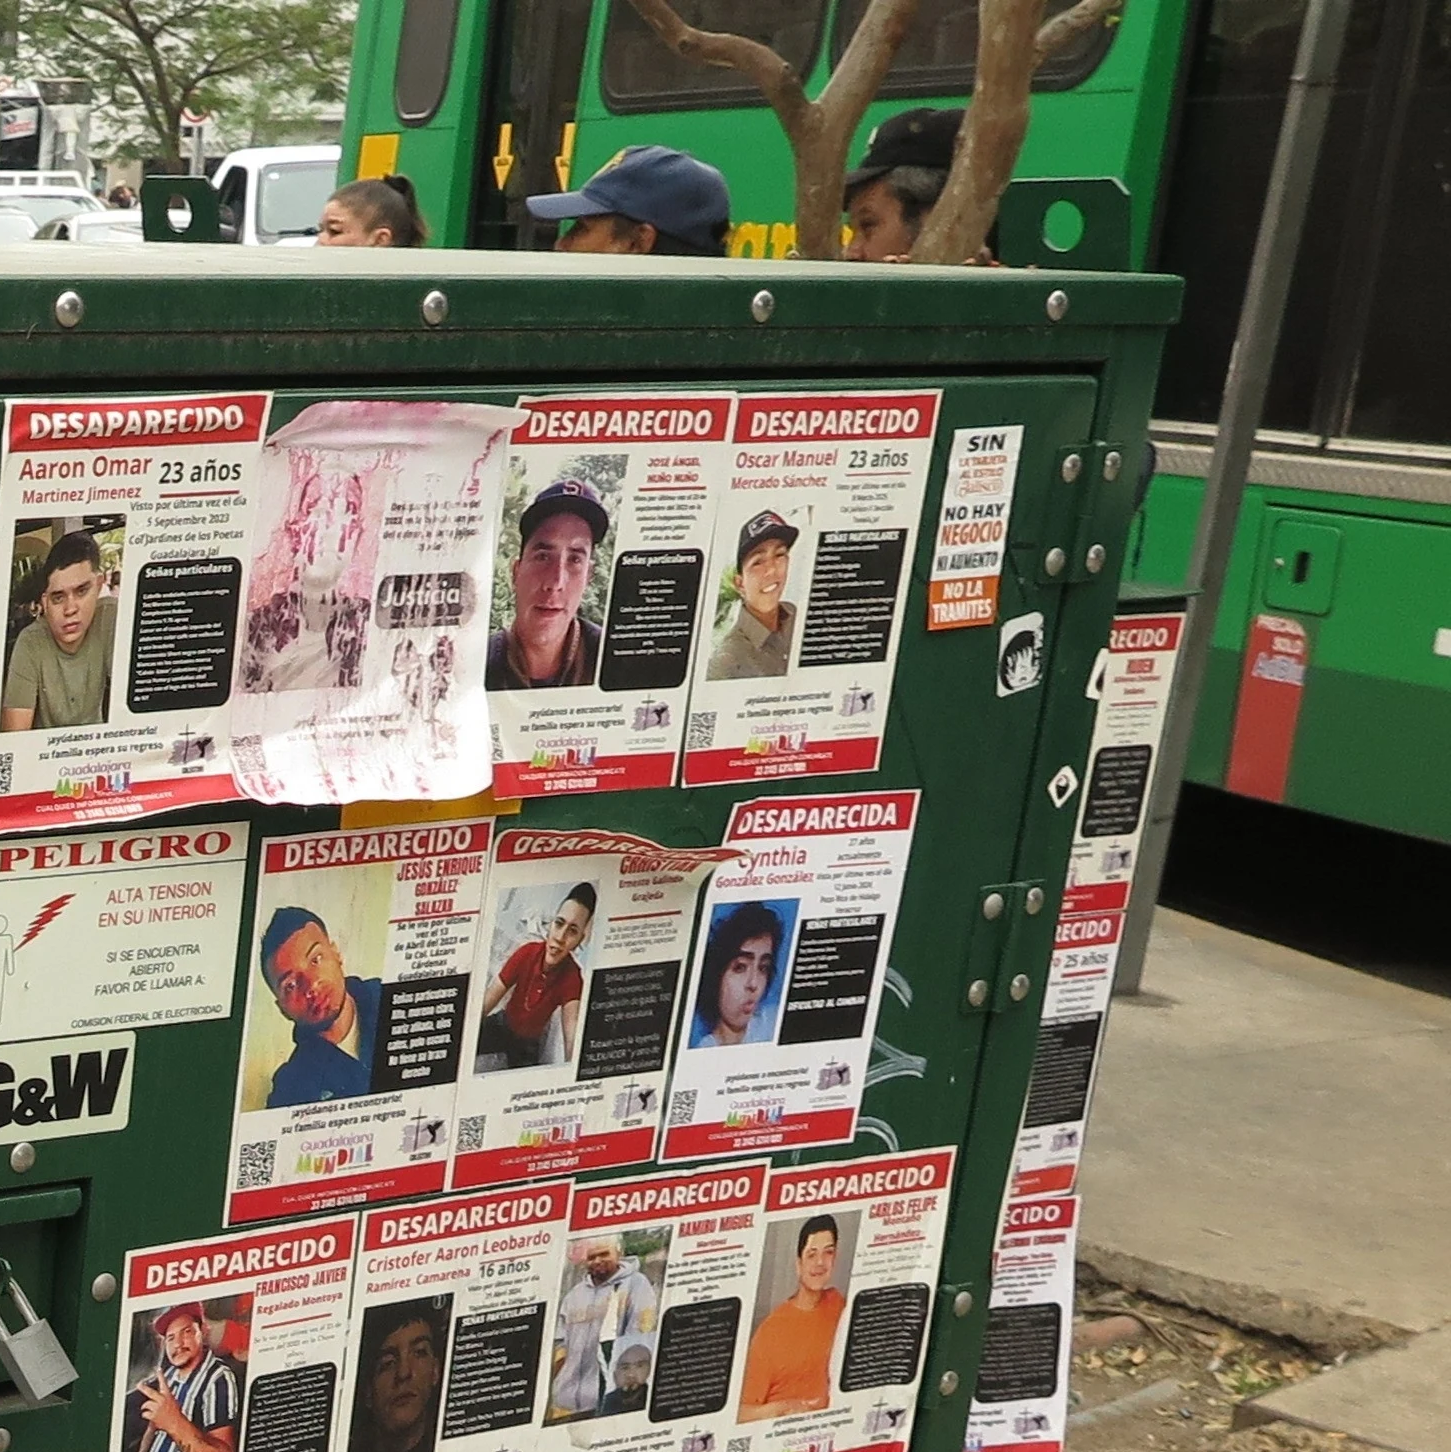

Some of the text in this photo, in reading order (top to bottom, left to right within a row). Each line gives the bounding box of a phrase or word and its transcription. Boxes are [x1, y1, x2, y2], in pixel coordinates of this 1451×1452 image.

[29, 405, 244, 442] DESAPARECIDO
[528, 408, 712, 439] DESAPARECIDO
[750, 408, 921, 438] DESAPARECIDO
[967, 433, 1007, 451] SIN
[19, 454, 152, 482] Aaron Omar
[159, 458, 242, 485] 23 años
[735, 447, 839, 470] Oscar Manuel
[847, 449, 909, 468] 23 años
[945, 503, 1005, 521] NO HAY
[940, 520, 1003, 547] NEGOCIO
[942, 580, 983, 598] NO LA
[932, 600, 992, 623] TRAMITES
[738, 802, 897, 835] DESAPARECIDA
[0, 831, 232, 872] PELIGRO
[284, 824, 472, 868] DESAPARECIDO
[106, 882, 212, 905] ALTA TENSION
[98, 903, 216, 927] EN SU INTERIOR
[106, 943, 201, 963] SI SE ENCUENTRA
[1065, 953, 1109, 967] 25 años
[130, 962, 175, 976] ABIERTO
[95, 980, 130, 995] FAVOR
[132, 979, 146, 992] DE
[149, 976, 191, 991] LLAMAR
[71, 1003, 223, 1028] COMISION FEDERAL DE ELECTRICIDAD
[586, 1176, 750, 1220] DESAPARECIDO
[780, 1164, 936, 1206] DESAPARECIDO
[379, 1194, 552, 1244] DESAPARECIDO
[146, 1235, 336, 1289] DESAPARECIDO
[366, 1232, 551, 1273] Cristofer Aaron Leobardo
[479, 1259, 530, 1279] 16 años
